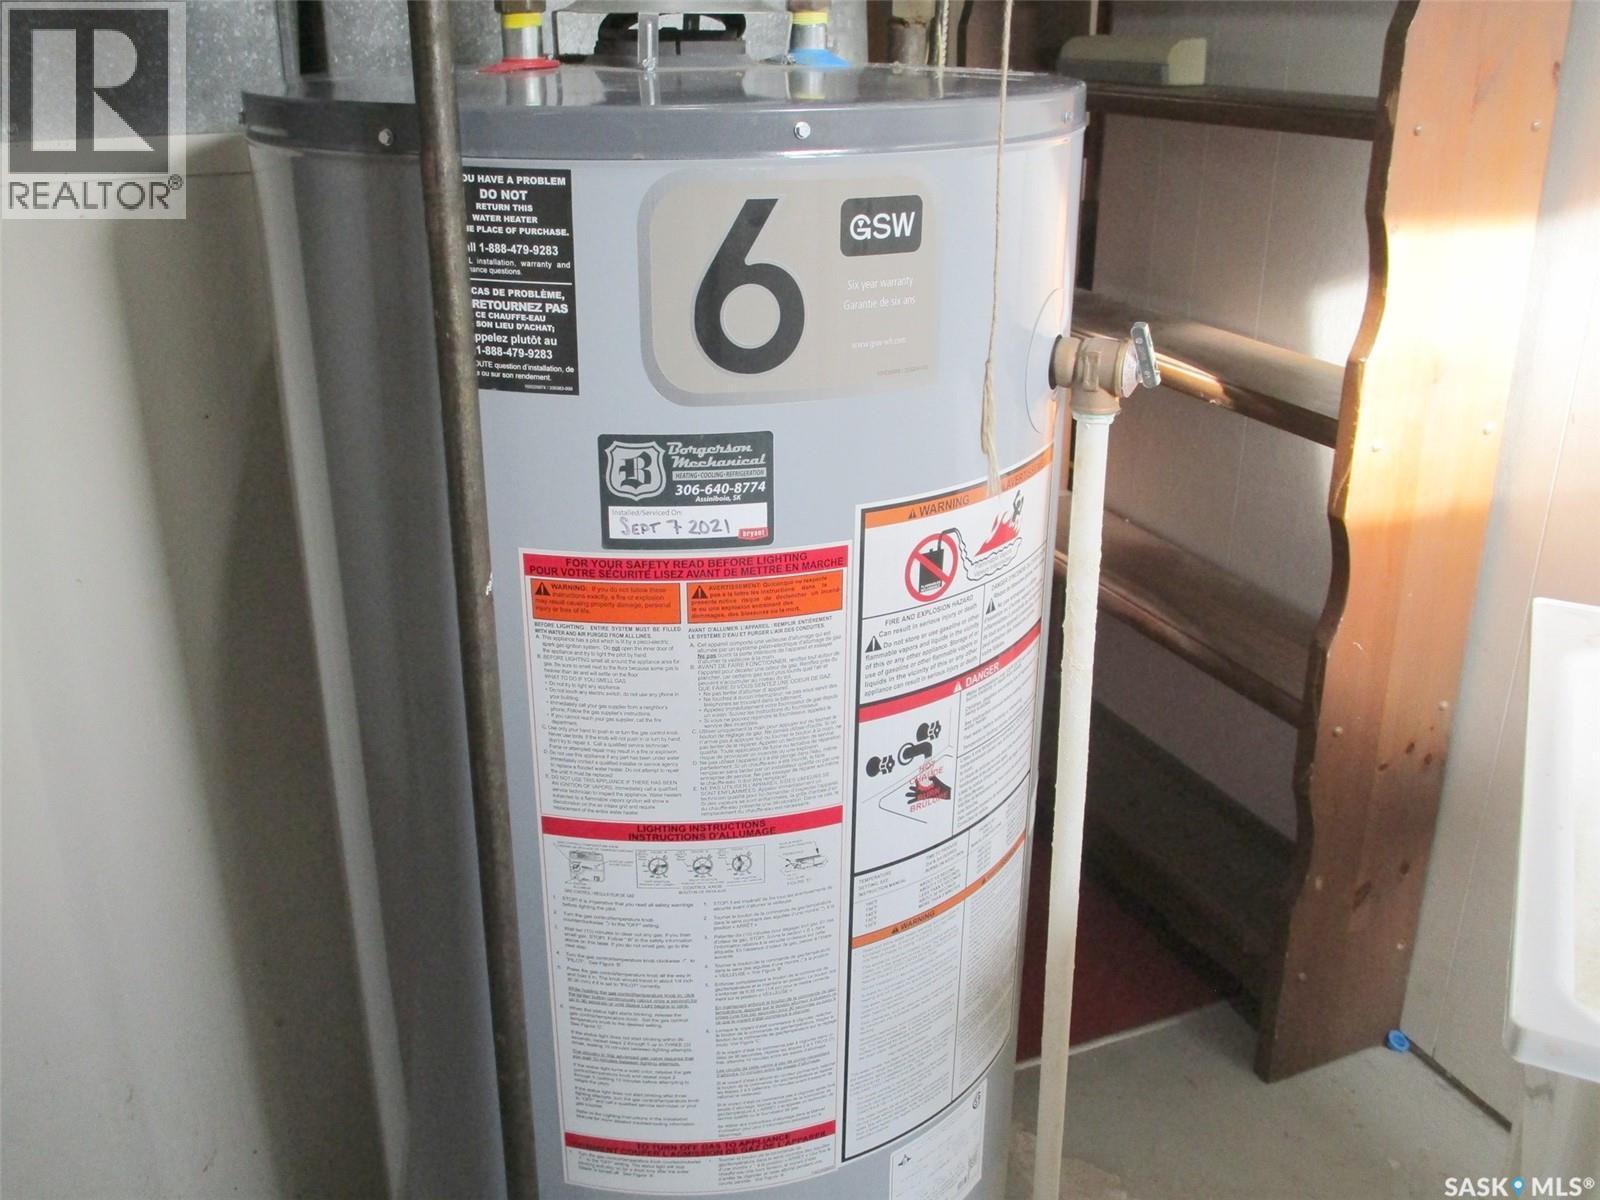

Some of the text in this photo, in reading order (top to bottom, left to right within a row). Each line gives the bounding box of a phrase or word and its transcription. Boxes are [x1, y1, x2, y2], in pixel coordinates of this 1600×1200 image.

[462, 174, 567, 186] OU HAVE A PROBLEM
[480, 189, 528, 201] DO NOT
[475, 203, 534, 212] RETURN THIS
[472, 214, 539, 224] WATER HEATER
[849, 211, 916, 240] GSW
[477, 225, 504, 234] PLACE
[506, 226, 517, 234] OF
[519, 227, 570, 236] PURCHASE.
[479, 243, 559, 256] 1-888-479-9283
[477, 258, 517, 267] installation,
[520, 261, 553, 270] warranty
[489, 267, 523, 276] questions.
[471, 286, 491, 296] CAS
[493, 288, 506, 297] DE
[694, 199, 805, 374] 6
[847, 276, 913, 292] Six year warranty
[471, 298, 569, 314] RETOURNEZ PAS
[843, 295, 916, 311] Garantie de six ans
[475, 311, 547, 322] CE CHAUFFE-EAU
[475, 320, 493, 328] SON
[494, 321, 515, 330] LIEU
[474, 333, 558, 346] ppelez plutôt au
[476, 345, 554, 360] 1-888-479-9283
[476, 360, 494, 368] OUTE
[494, 362, 522, 371] question
[666, 442, 753, 458] Borgerson
[671, 453, 768, 469] Mechanical
[675, 481, 767, 497] 306-640-8774
[733, 494, 742, 502] SK
[919, 496, 970, 515] WARNING
[666, 519, 682, 535] 7
[688, 518, 730, 535] 2021
[529, 565, 559, 575] POUR
[561, 567, 597, 578] VOTRE
[654, 570, 684, 579] LISEZ
[686, 569, 720, 579] AVANT
[723, 569, 738, 577] DE
[741, 564, 784, 576] METTRE
[785, 563, 801, 572] EN
[802, 556, 844, 571] MARCHE
[566, 552, 808, 569] FOR YOUR SAFETY READ BEFORE LIGHTING
[885, 594, 975, 627] FIRE AND EXPLOSION HAZARD
[879, 630, 892, 638] Can
[893, 625, 912, 635] result
[919, 617, 940, 628] serious
[905, 635, 920, 643] store
[965, 662, 1000, 688] DANGER
[628, 826, 778, 841] INSTRUCTIONS D'ALLUMAGE
[636, 819, 767, 833] LIGHTING INSTRUCTIONS
[900, 910, 936, 931] WARNING
